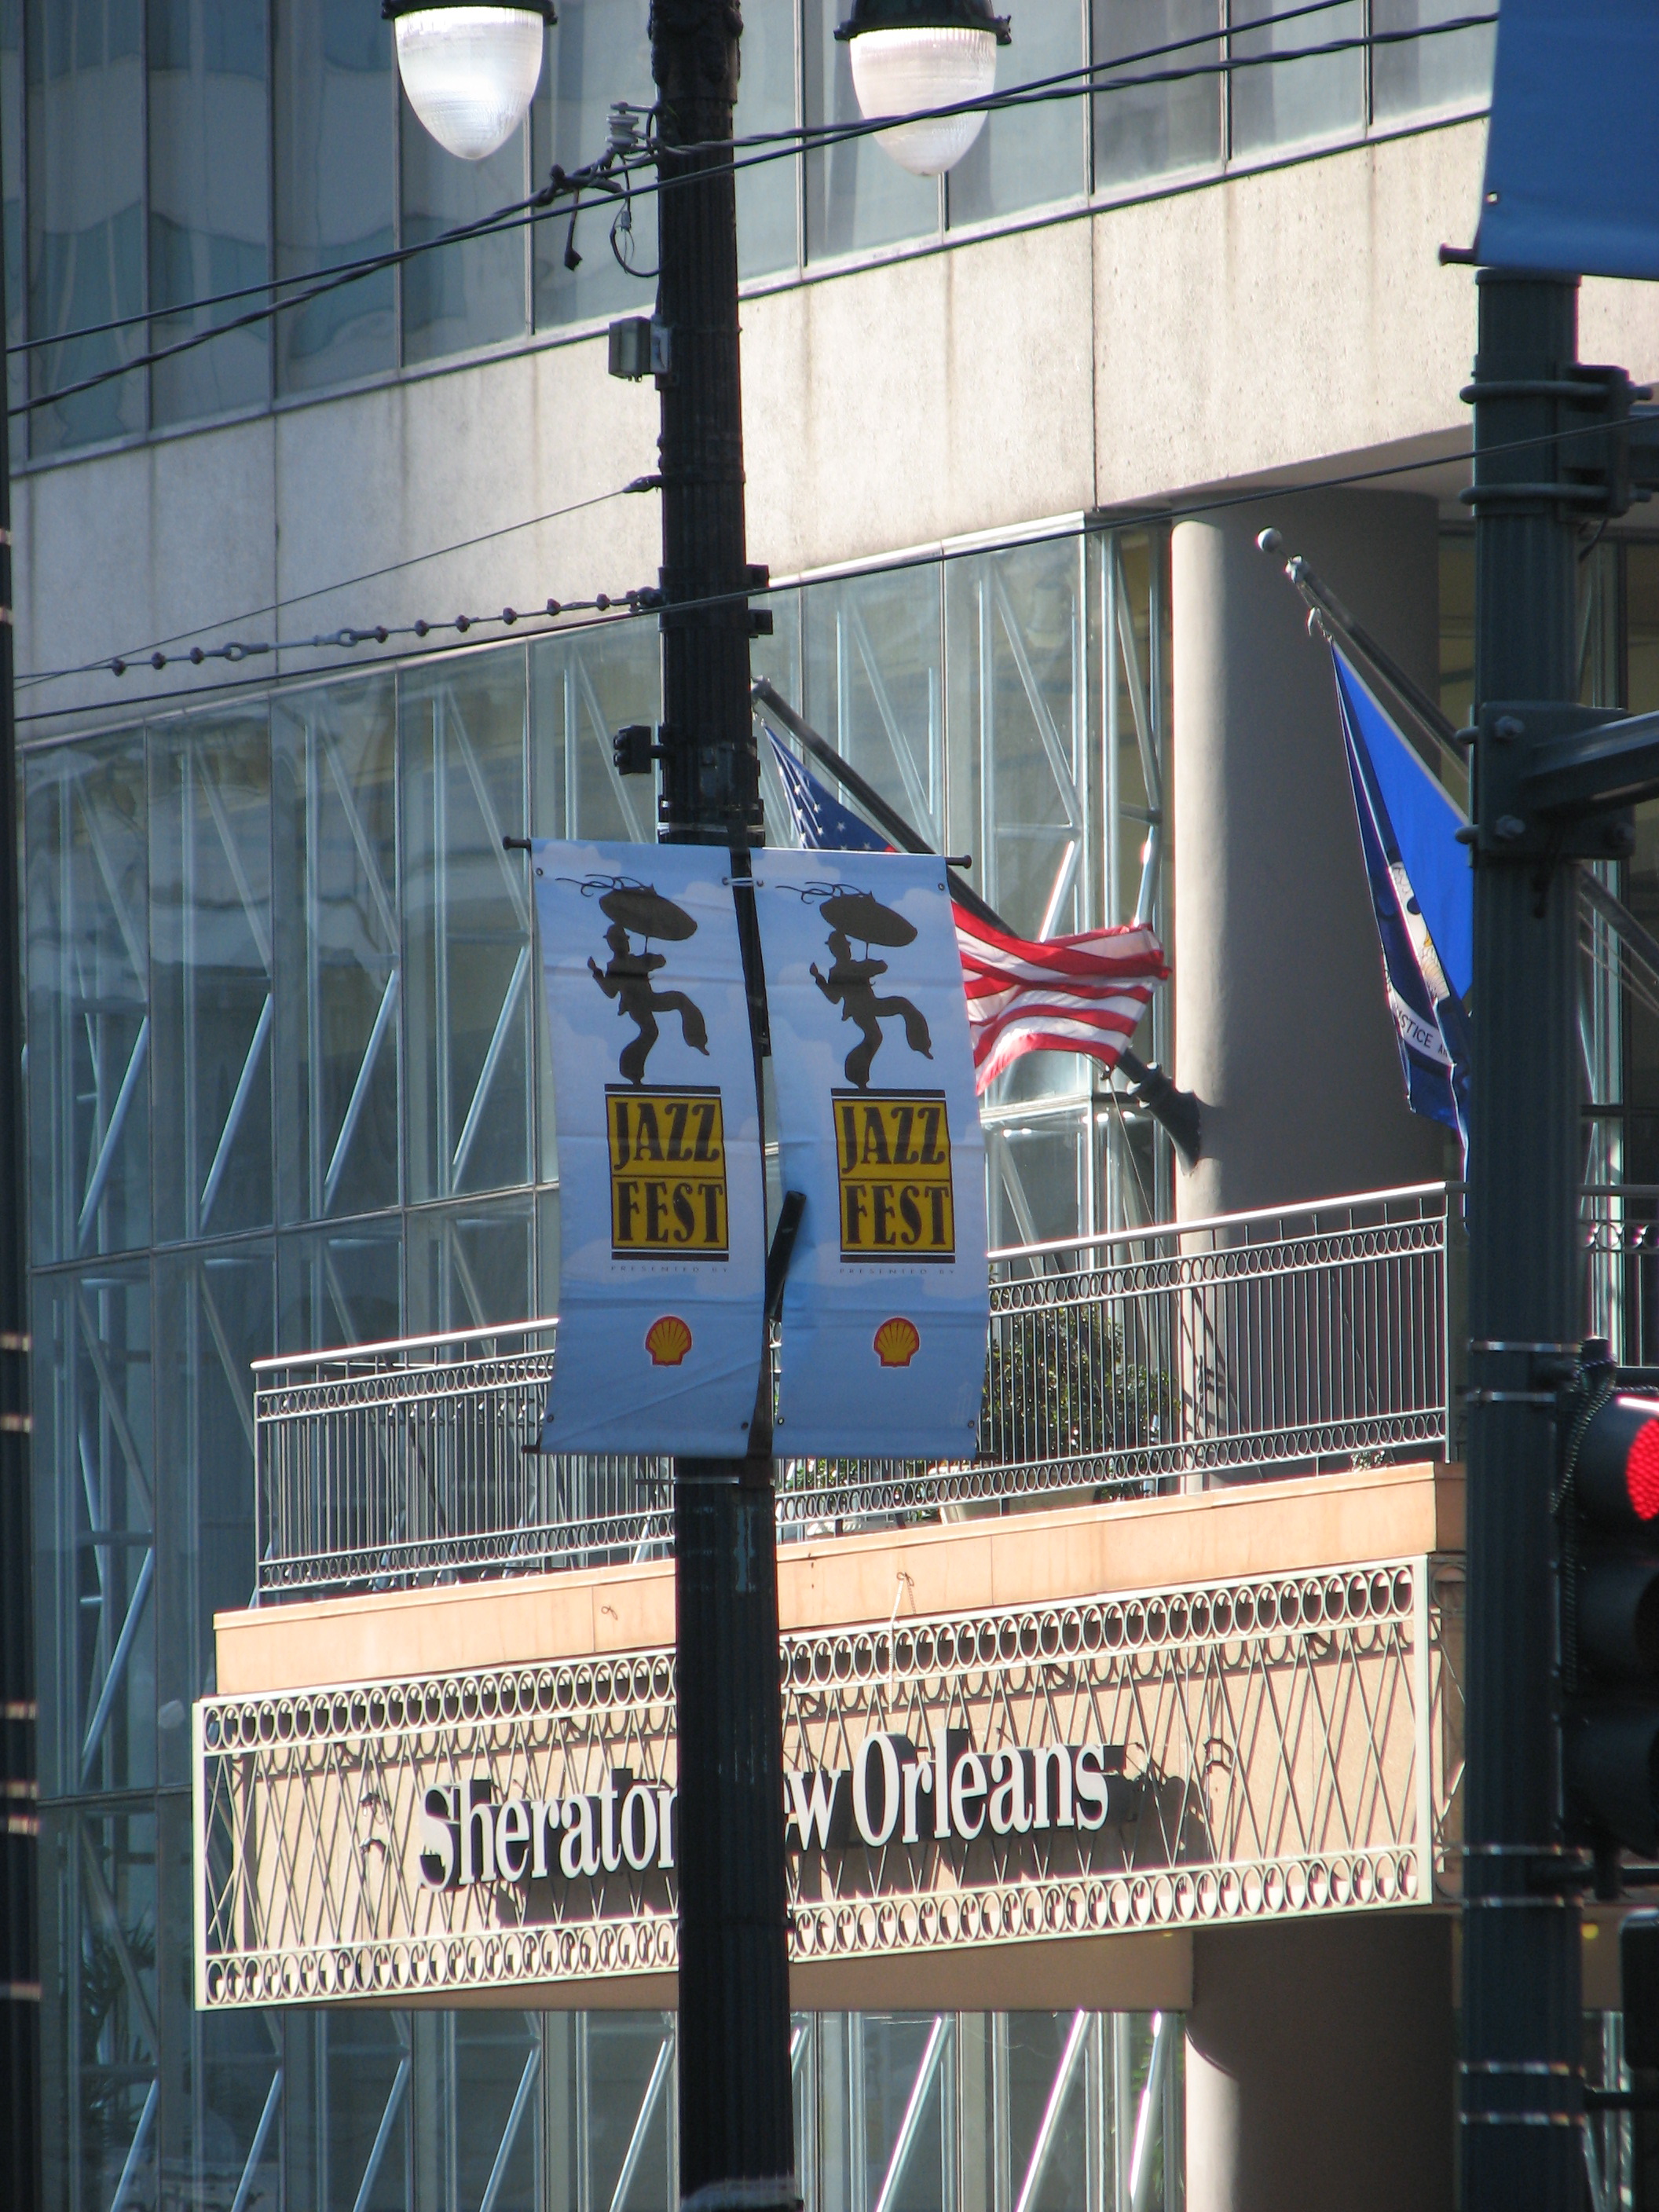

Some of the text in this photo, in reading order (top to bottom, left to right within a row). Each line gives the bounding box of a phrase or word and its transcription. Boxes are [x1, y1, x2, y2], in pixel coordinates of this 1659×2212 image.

[613, 1101, 720, 1170] JAZZ
[840, 1105, 947, 1174] JAZZ
[617, 1181, 723, 1243] FEST
[844, 1185, 950, 1245] FEST
[852, 1728, 1110, 1848] Orleans
